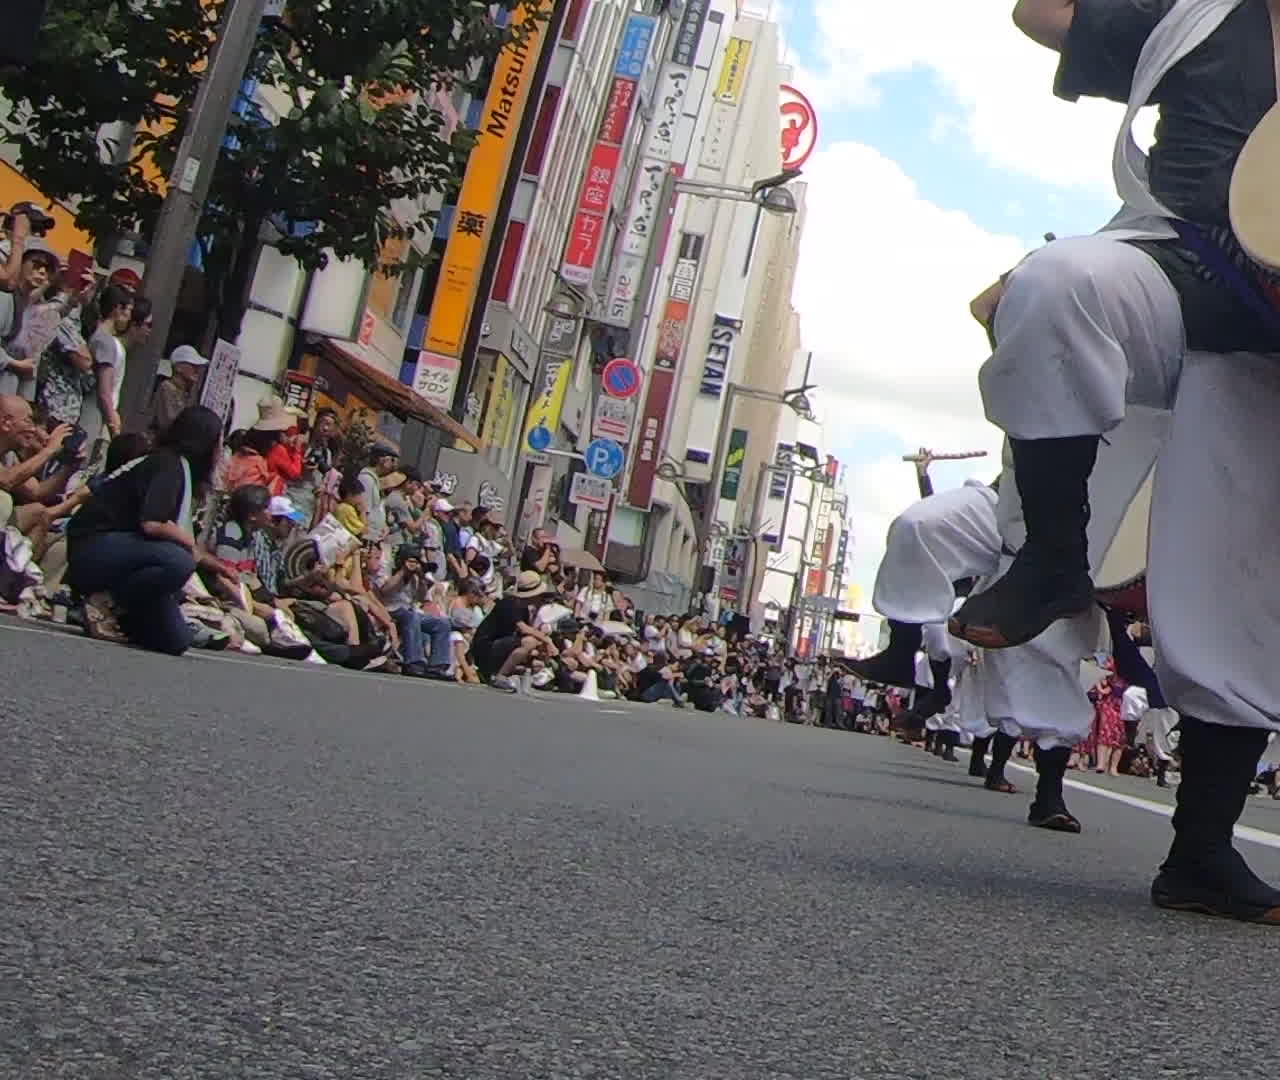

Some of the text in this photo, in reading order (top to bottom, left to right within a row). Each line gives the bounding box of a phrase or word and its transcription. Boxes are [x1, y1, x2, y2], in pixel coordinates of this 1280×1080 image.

[700, 312, 744, 400] ISETAN
[421, 368, 450, 384] ネイル
[417, 381, 450, 395] サロン
